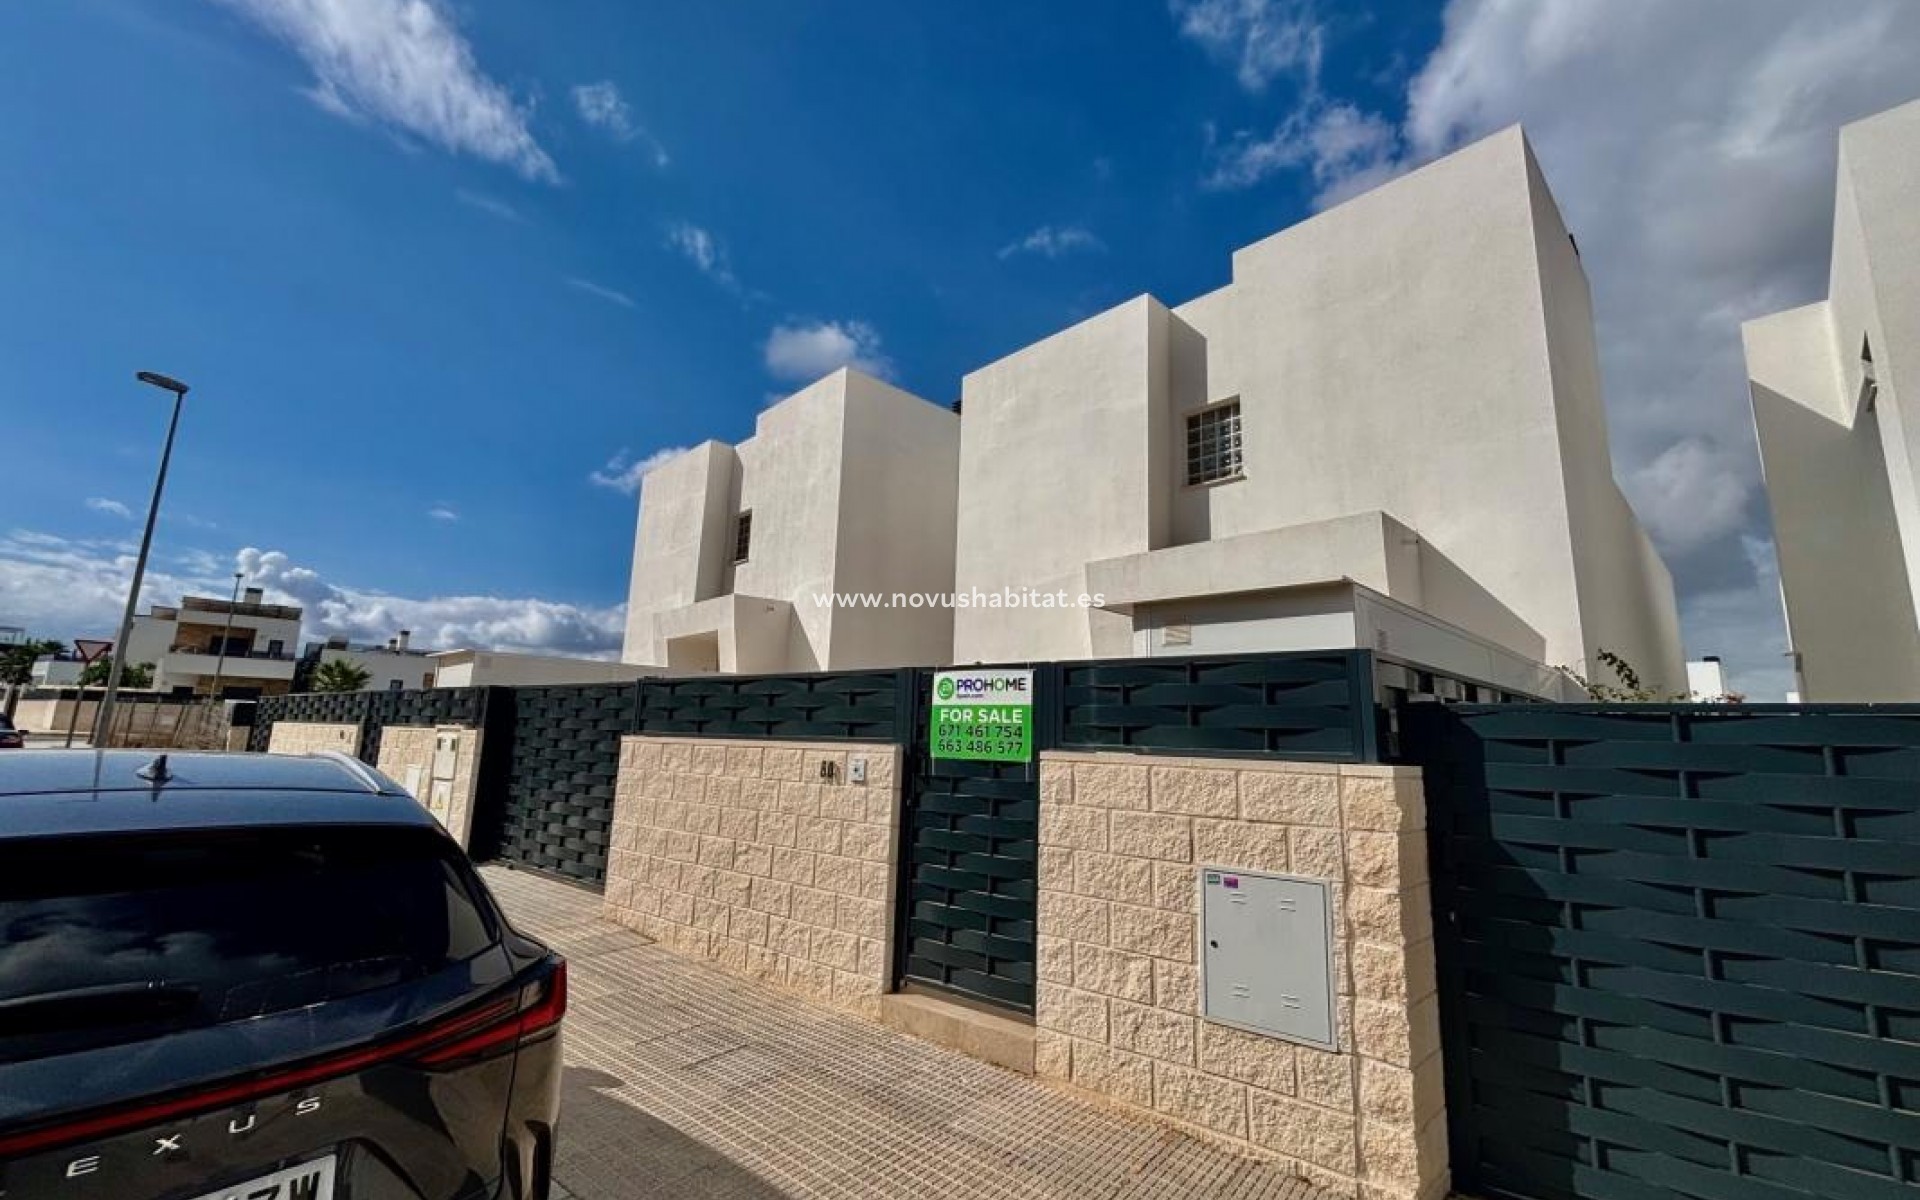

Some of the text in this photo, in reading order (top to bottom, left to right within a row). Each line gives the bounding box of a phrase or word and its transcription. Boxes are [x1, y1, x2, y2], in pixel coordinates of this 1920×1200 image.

[956, 677, 1027, 692] PROHOME
[940, 708, 1023, 724] FOR SALE
[938, 724, 1023, 738] 671 461 754
[938, 739, 1023, 755] 663 486 577
[0, 1096, 321, 1197] EXUS
